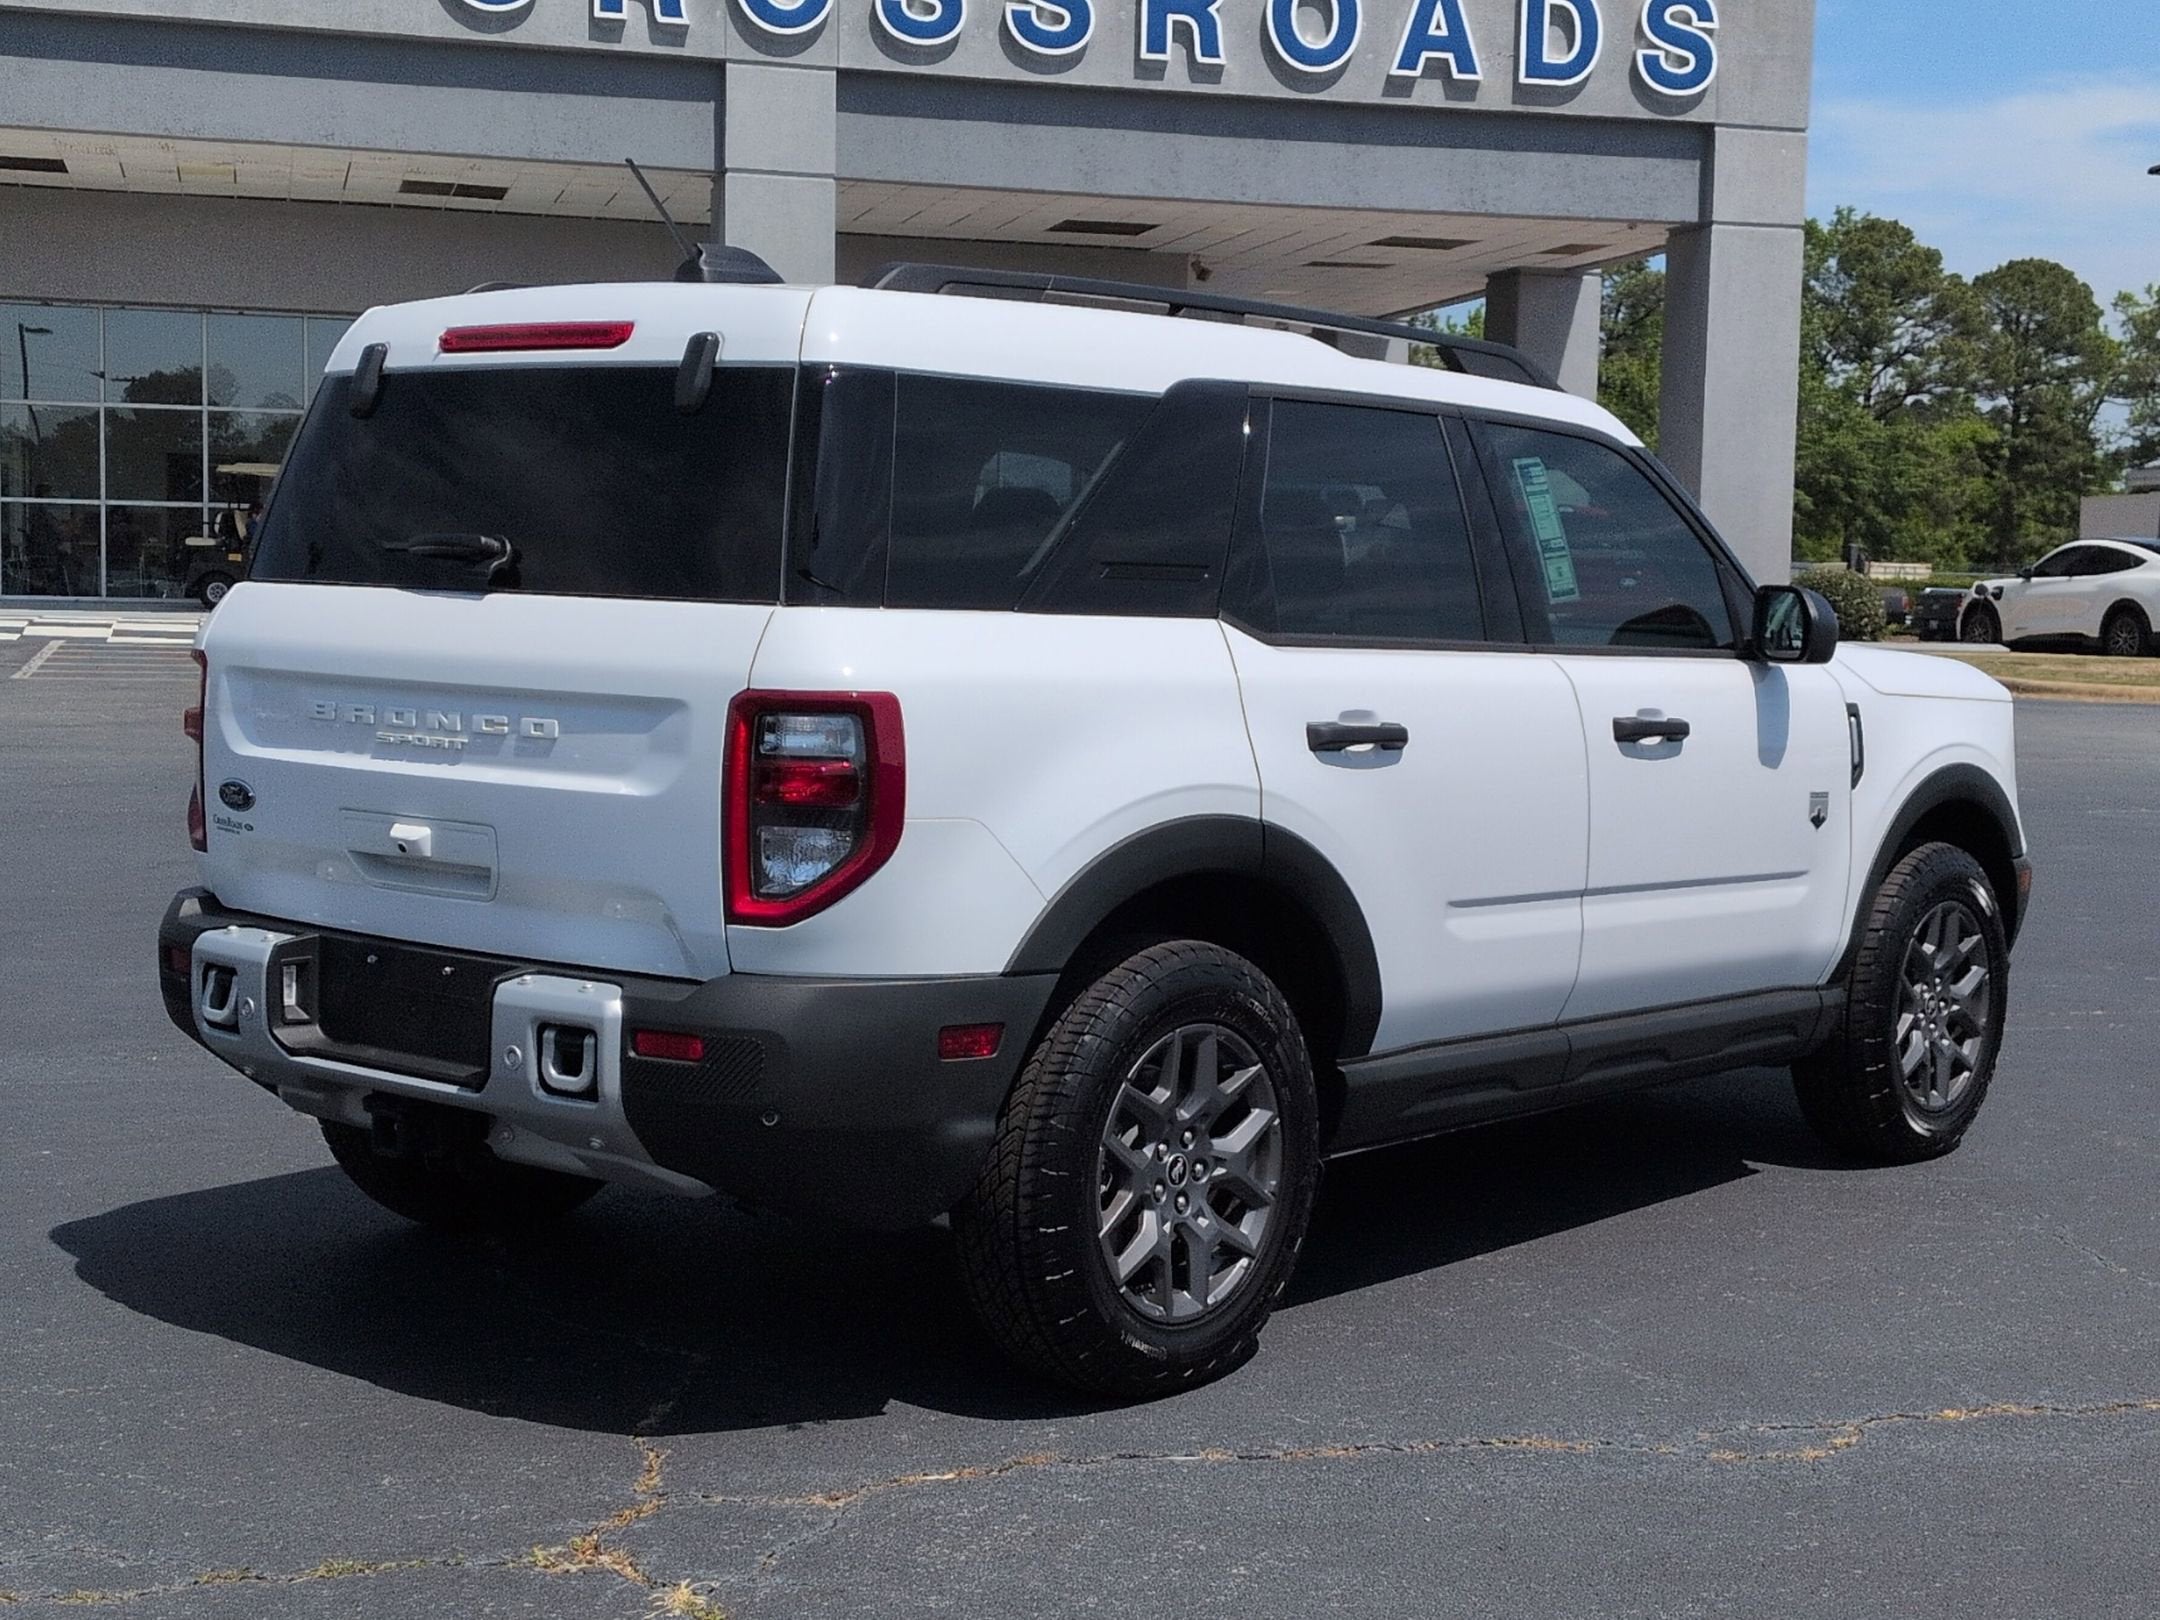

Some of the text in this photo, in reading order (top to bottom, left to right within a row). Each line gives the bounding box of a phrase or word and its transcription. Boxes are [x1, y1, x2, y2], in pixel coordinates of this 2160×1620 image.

[461, 0, 1719, 96] SROADS
[308, 702, 560, 740] BRONCO
[375, 731, 469, 750] SPORT
